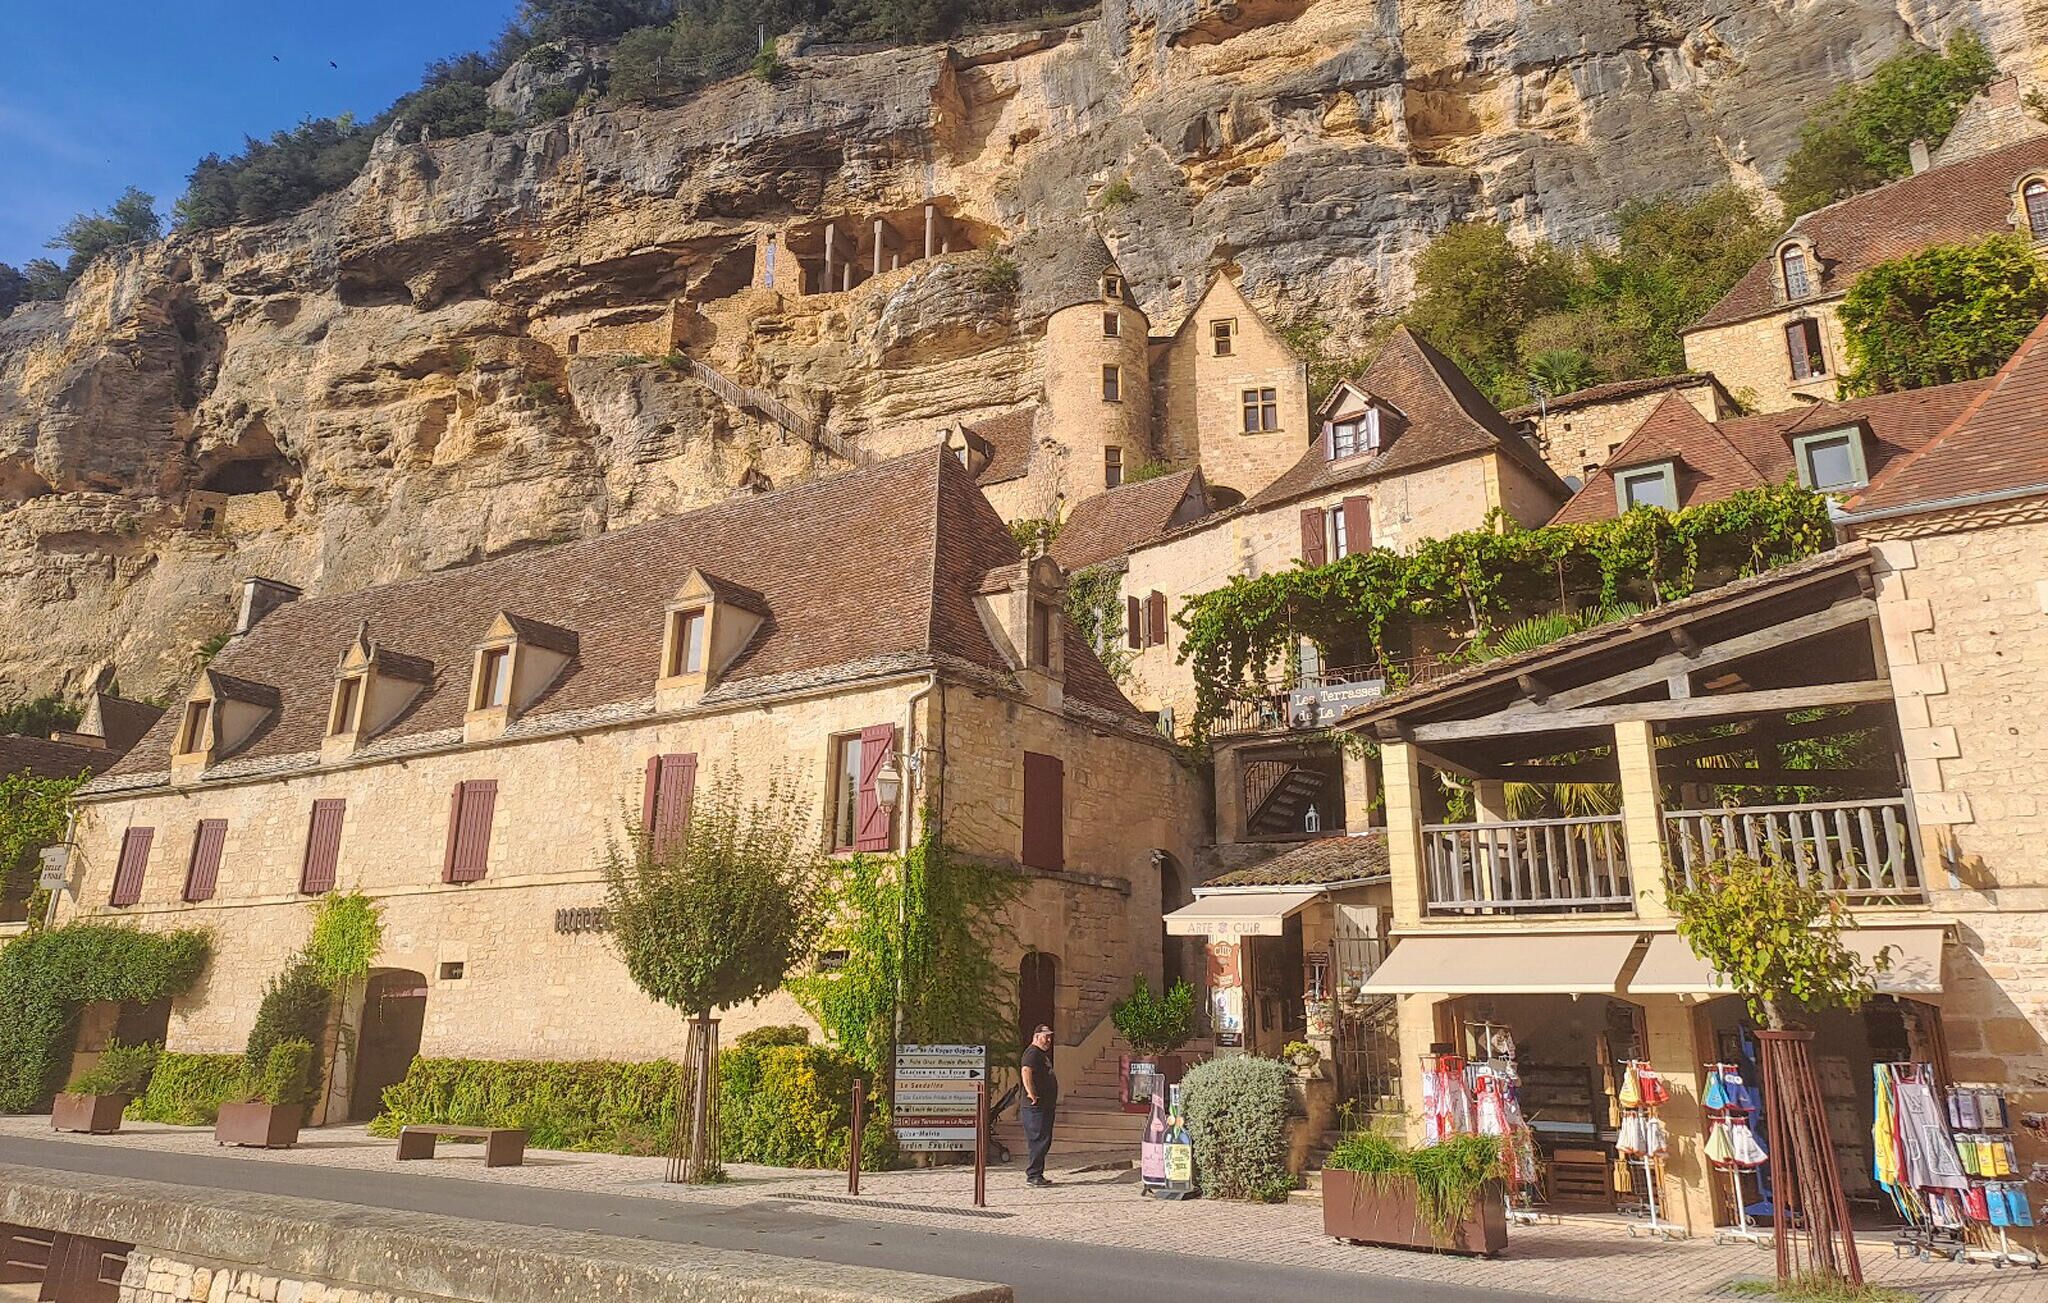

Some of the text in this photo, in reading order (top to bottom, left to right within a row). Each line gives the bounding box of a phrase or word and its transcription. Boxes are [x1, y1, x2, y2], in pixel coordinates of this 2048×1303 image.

[1294, 686, 1380, 706] Les Terrasses
[1298, 710, 1313, 721] de
[1319, 707, 1335, 719] La
[1187, 922, 1213, 933] ARTE
